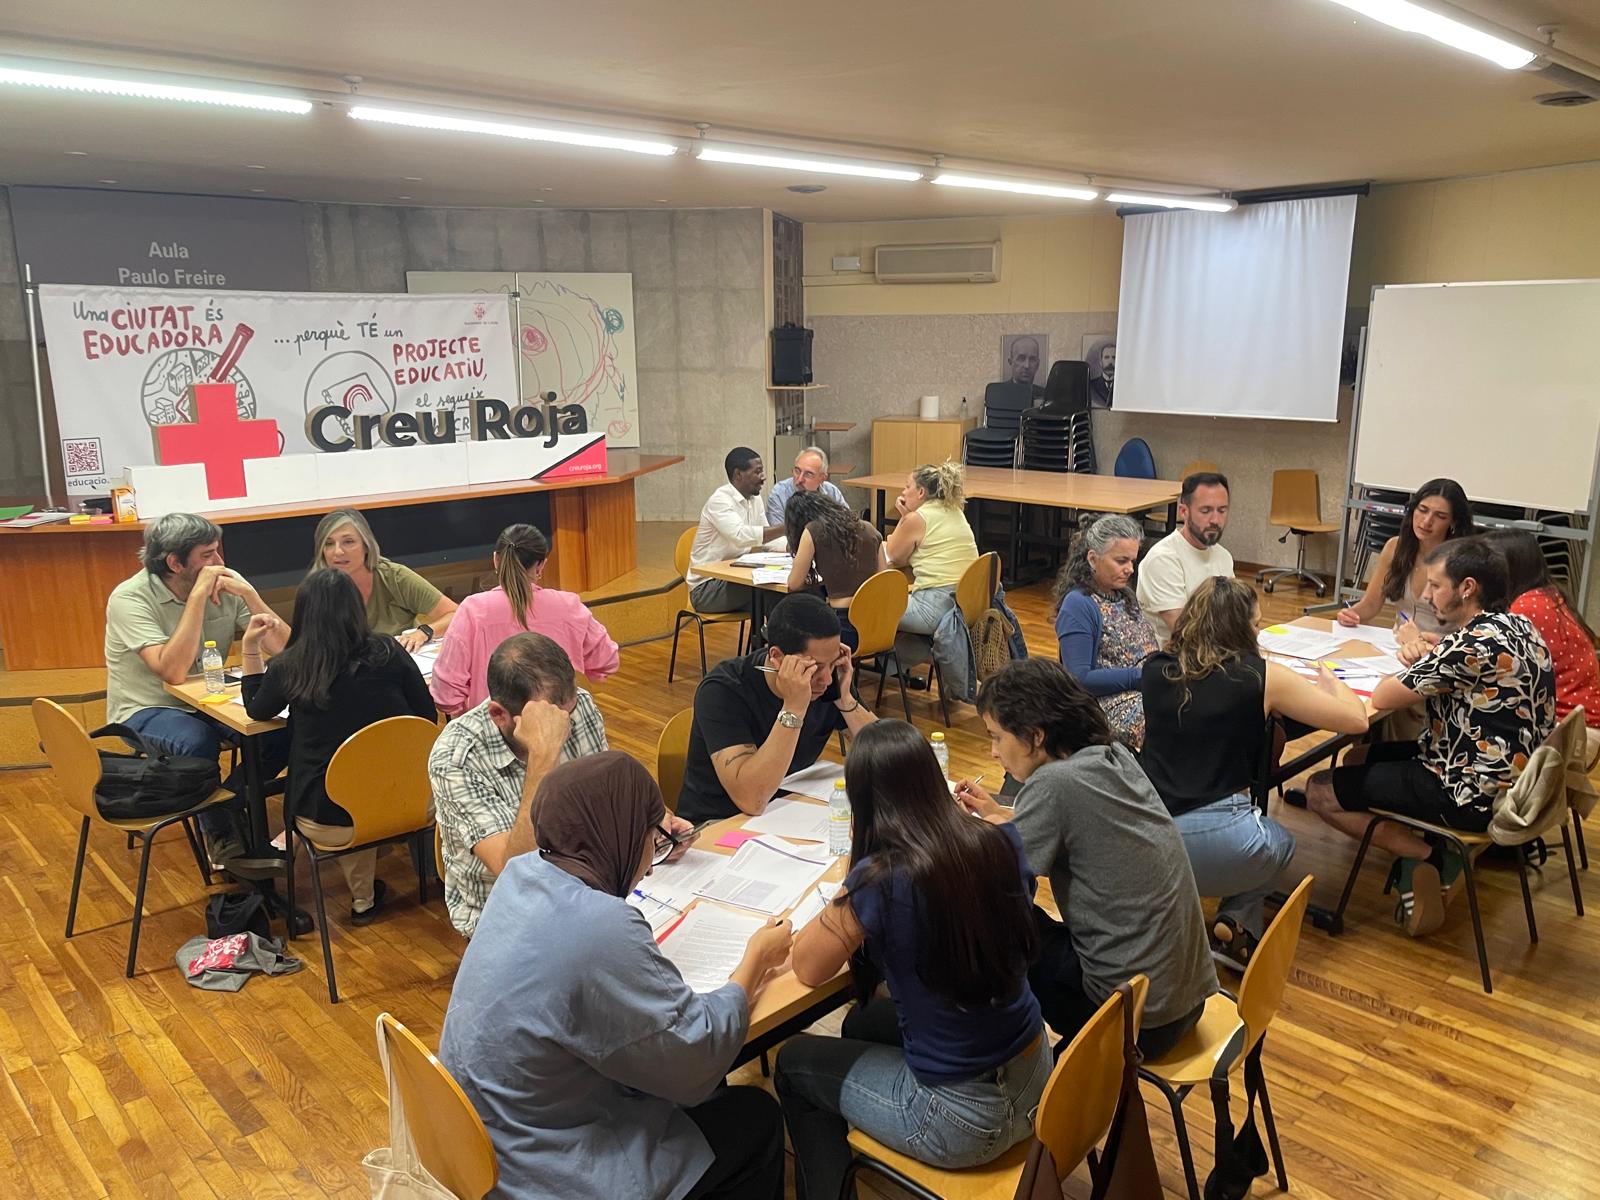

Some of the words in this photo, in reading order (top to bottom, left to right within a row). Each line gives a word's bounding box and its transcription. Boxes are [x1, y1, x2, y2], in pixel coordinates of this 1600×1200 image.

[149, 241, 189, 259] Aula
[118, 267, 170, 285] Paulo
[174, 268, 226, 286] Freire
[73, 301, 109, 322] Una
[357, 313, 379, 338] TÉ
[384, 328, 404, 339] un
[83, 324, 223, 360] EDUCADORA
[393, 336, 481, 366] PROJECTE
[415, 393, 432, 408] el
[436, 386, 485, 412] segueix
[305, 404, 457, 453] Creu
[469, 391, 589, 449] Roja
[568, 463, 602, 472] creuroja.org
